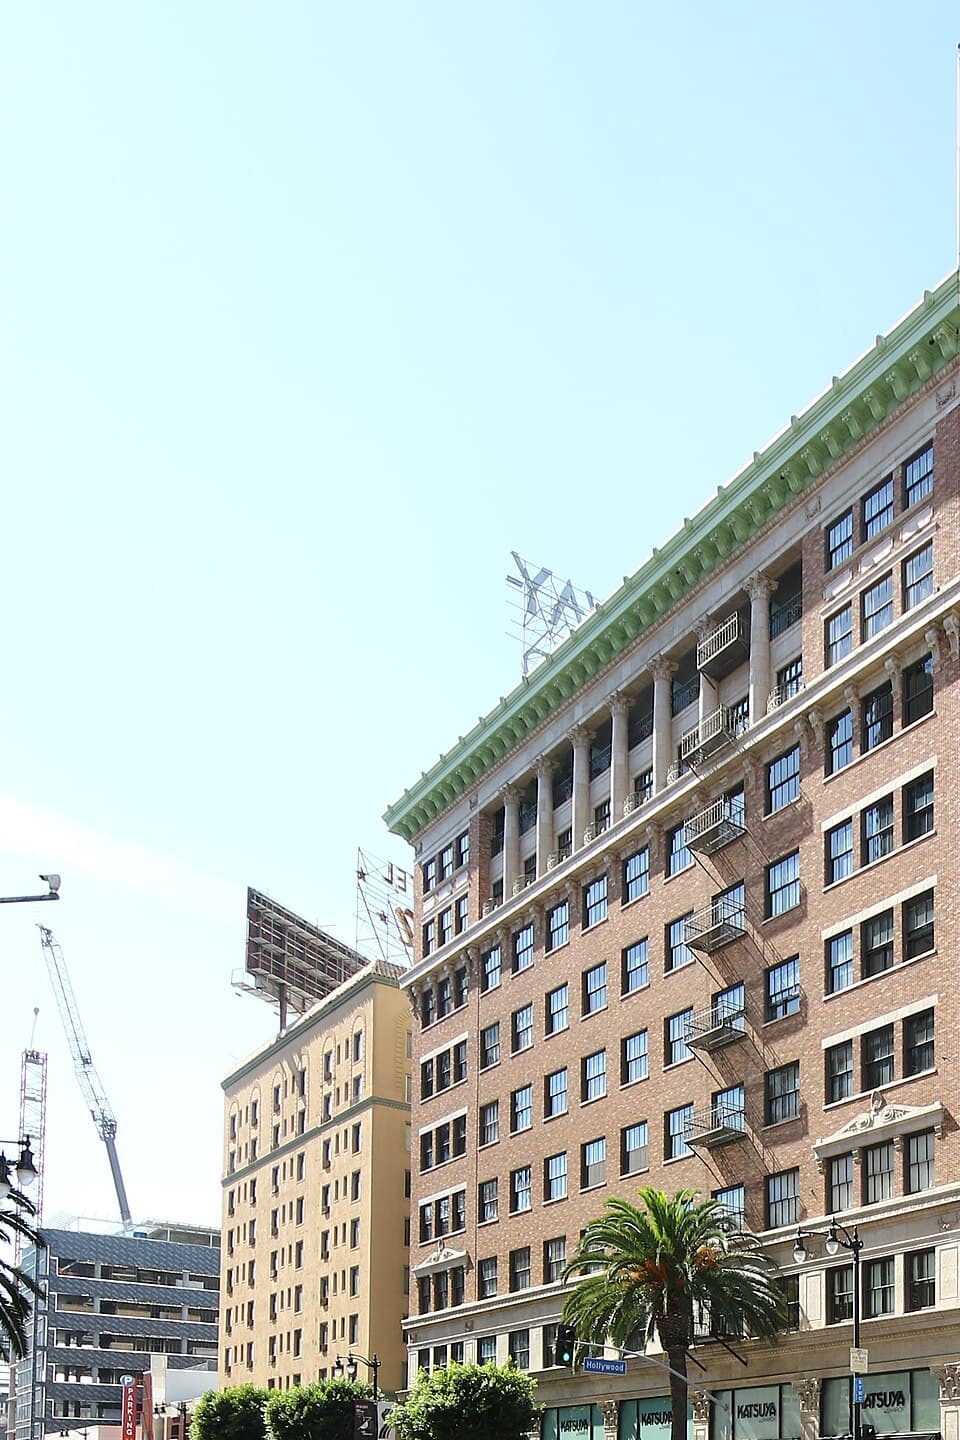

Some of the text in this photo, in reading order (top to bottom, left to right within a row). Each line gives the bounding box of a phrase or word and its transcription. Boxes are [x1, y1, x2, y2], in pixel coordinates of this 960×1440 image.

[586, 1360, 624, 1373] Hollywood
[737, 1402, 777, 1419] KATSUYA
[560, 1418, 588, 1433] KATSUYA
